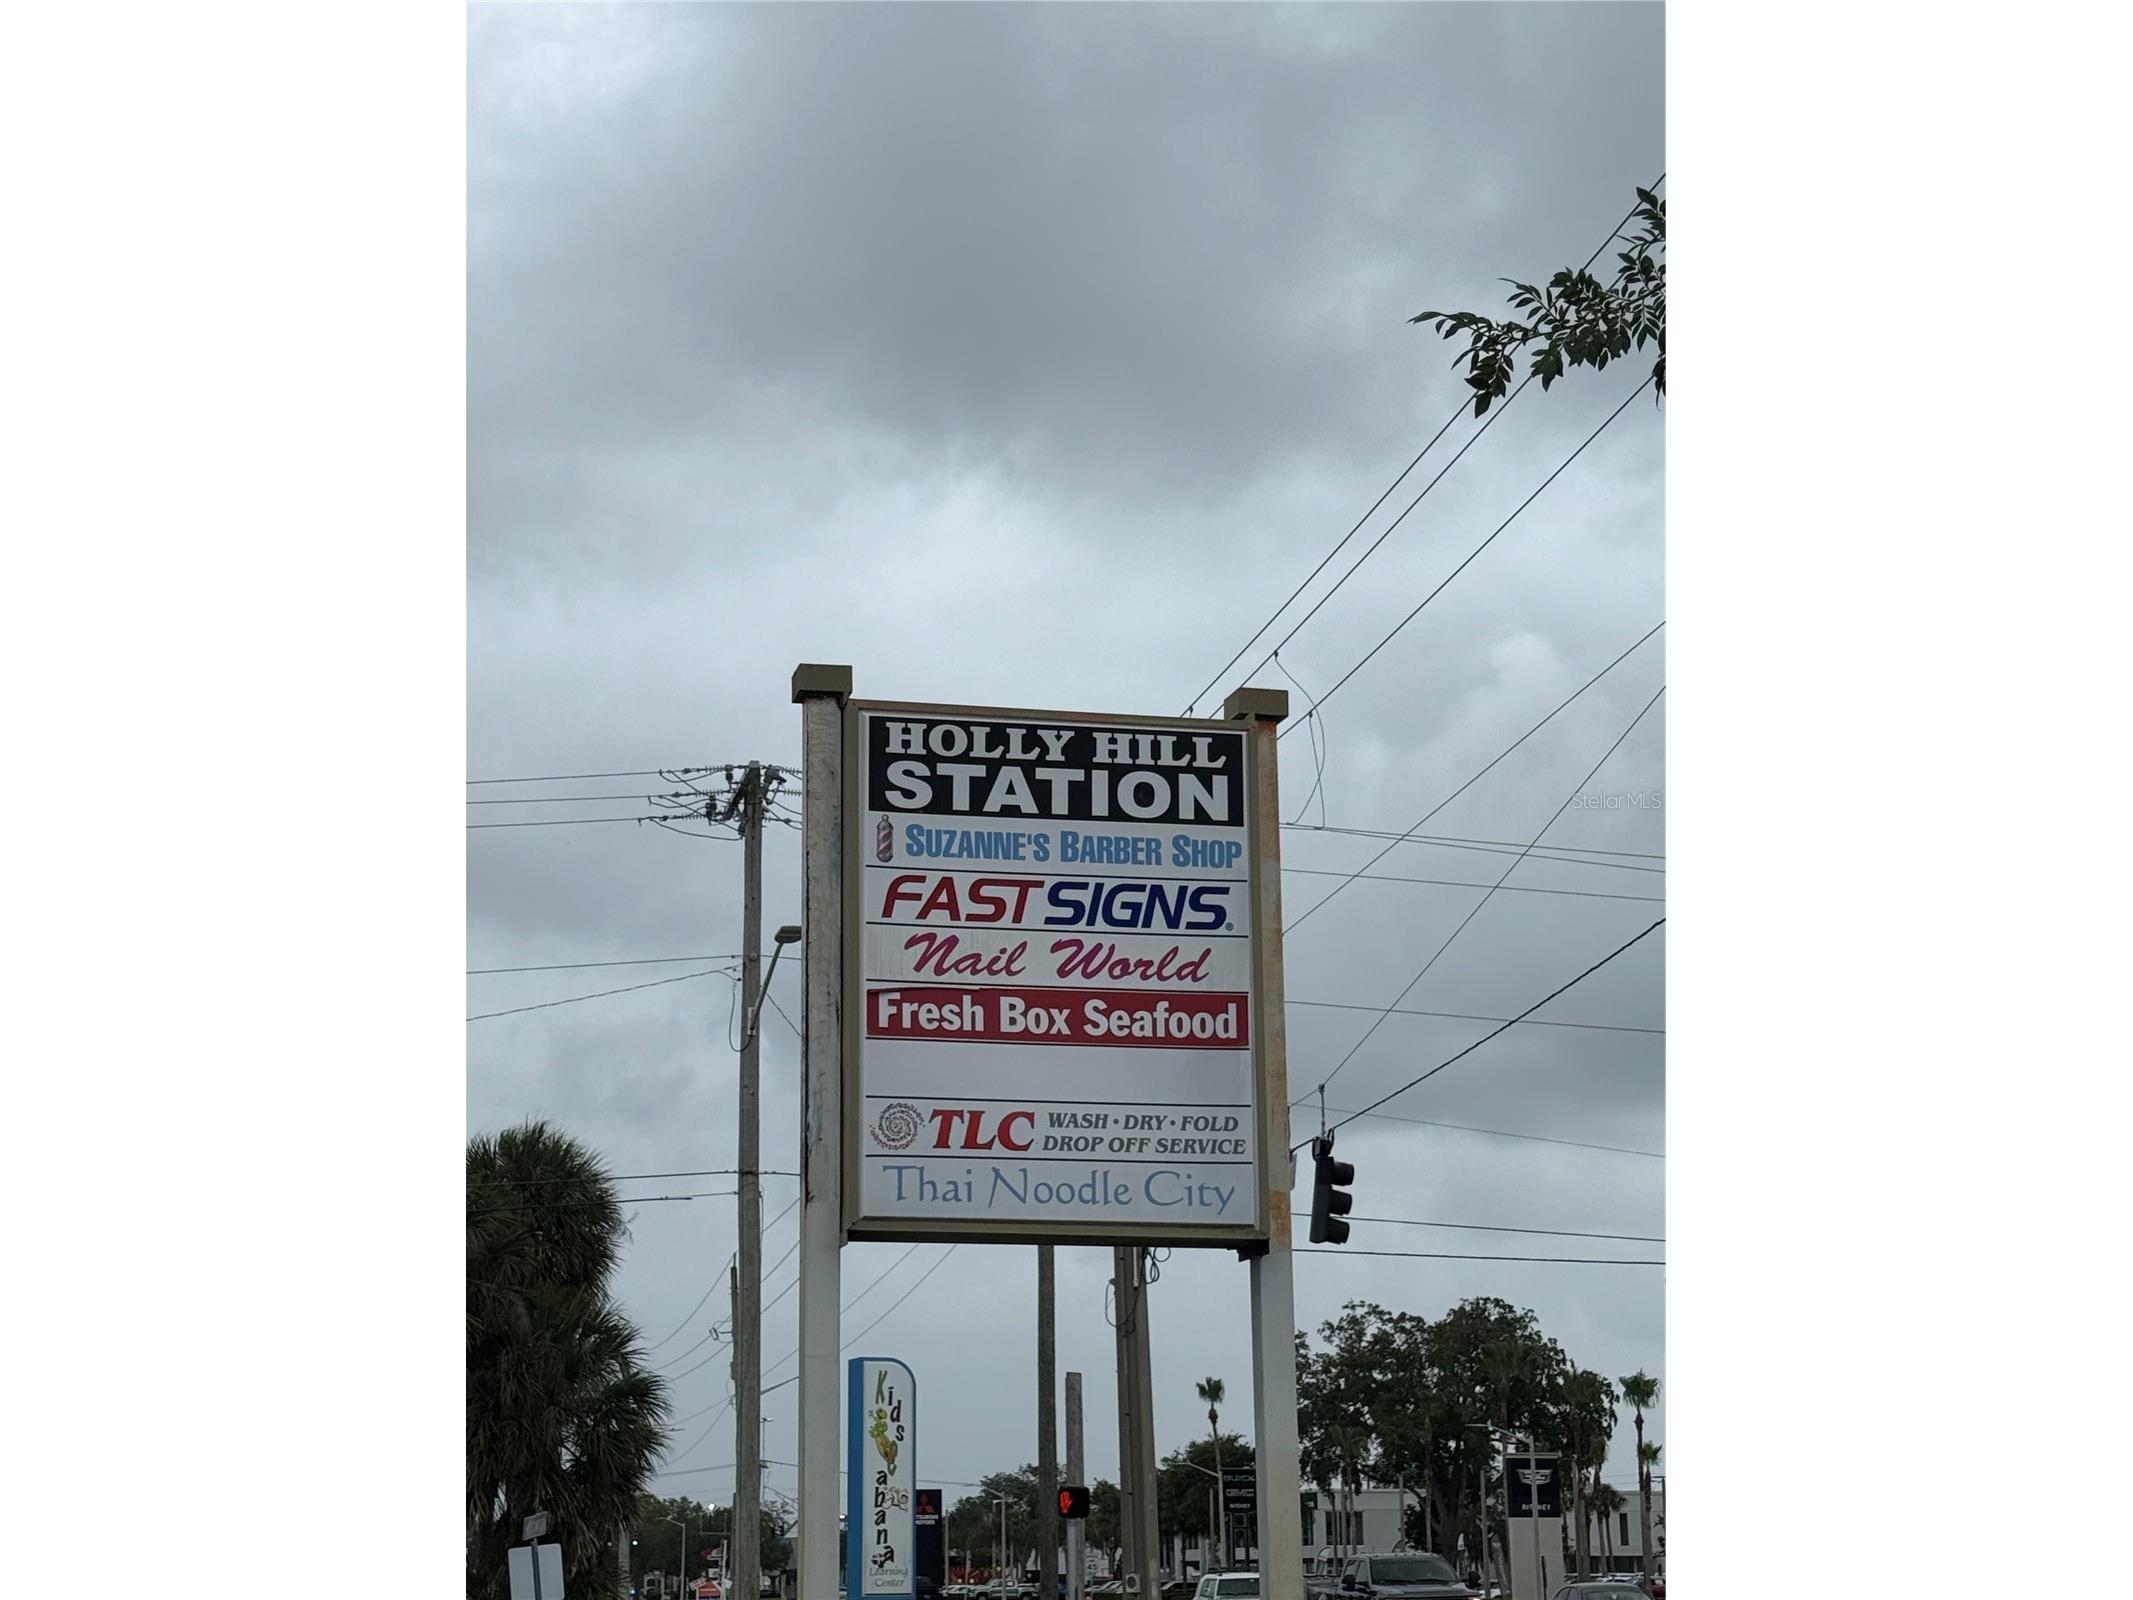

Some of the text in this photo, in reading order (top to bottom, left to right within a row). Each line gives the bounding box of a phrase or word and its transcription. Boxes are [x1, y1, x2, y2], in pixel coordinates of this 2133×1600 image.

[885, 721, 1228, 769] HOLLY HILL
[884, 760, 1230, 821] STATION
[905, 824, 1242, 869] SUZANNE'S BARBER SHOP
[903, 931, 1212, 983] Nail World
[878, 992, 1237, 1039] Fresh Box Seafood
[929, 1109, 1035, 1151] TLC
[1042, 1135, 1246, 1155] DROP OFF SERVICE
[1048, 1112, 1239, 1132] WASH DRY FOLD
[882, 1165, 1236, 1216] Thai Noodle City
[875, 1370, 905, 1441] Kids
